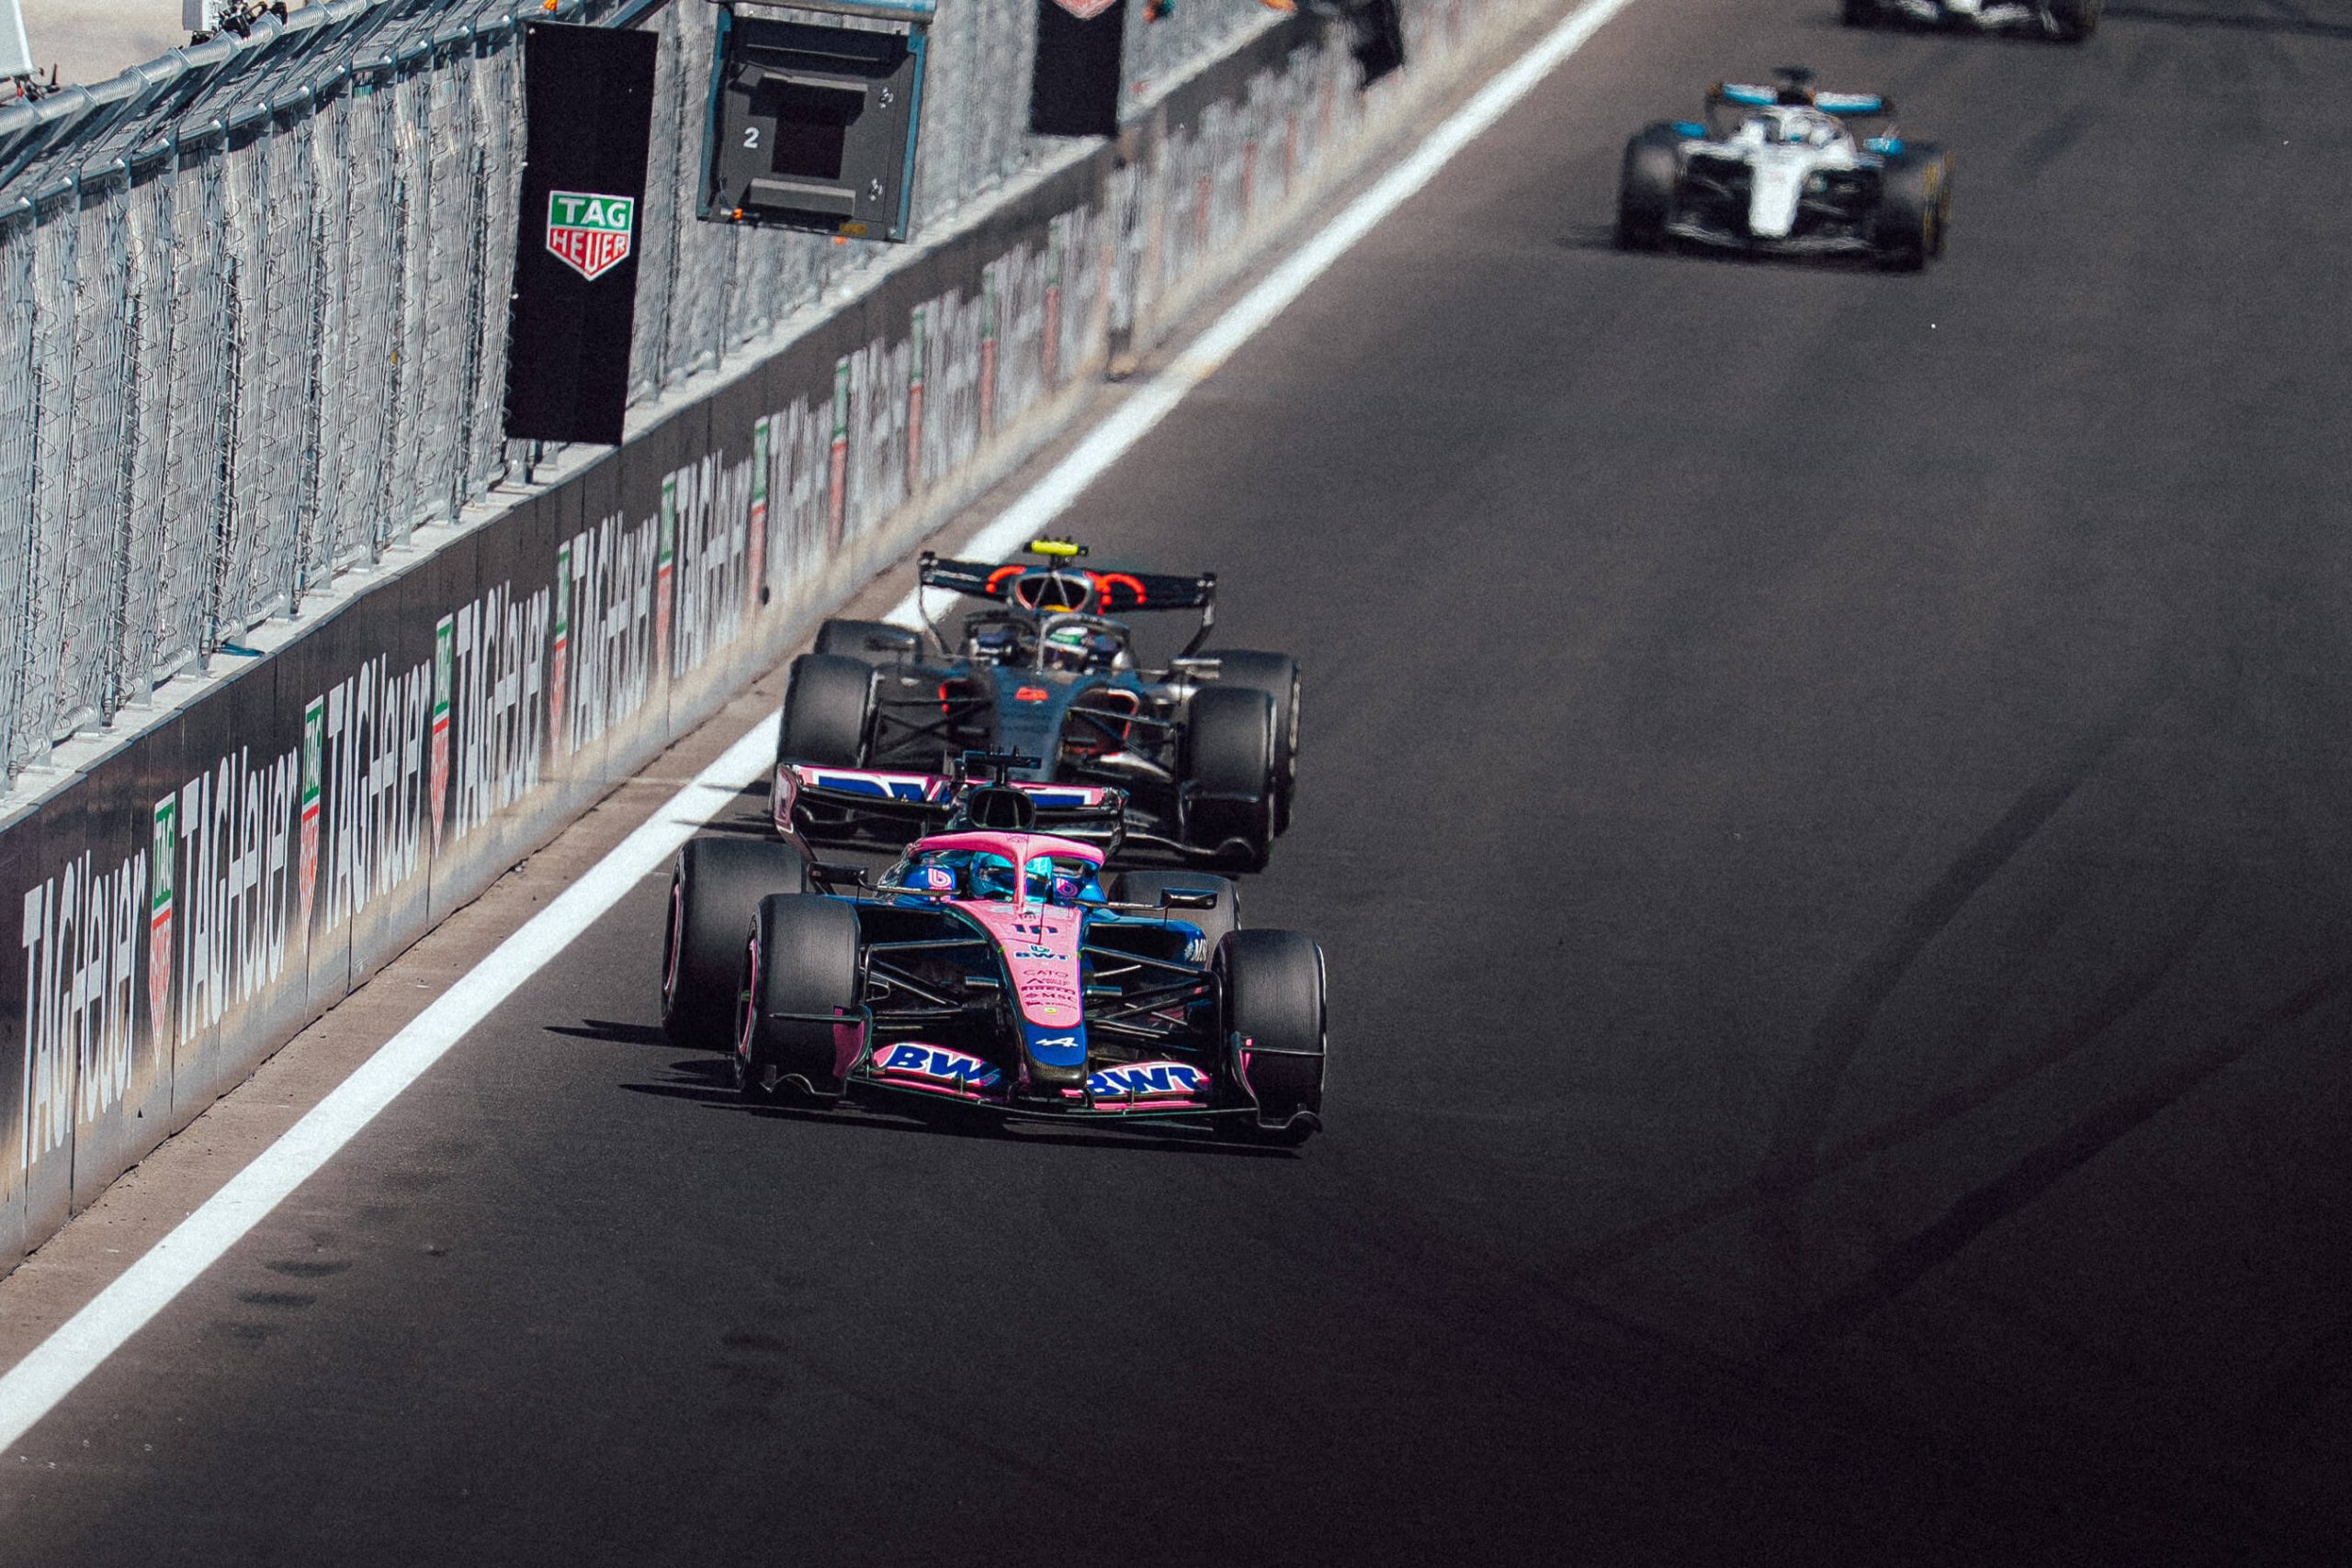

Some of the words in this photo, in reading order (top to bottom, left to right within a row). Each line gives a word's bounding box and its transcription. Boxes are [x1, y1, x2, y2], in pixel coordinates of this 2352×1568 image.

[743, 127, 760, 149] 2
[558, 197, 626, 228] TAG
[552, 230, 626, 272] HEUER
[304, 713, 321, 796] TAG
[155, 811, 174, 900] TAG
